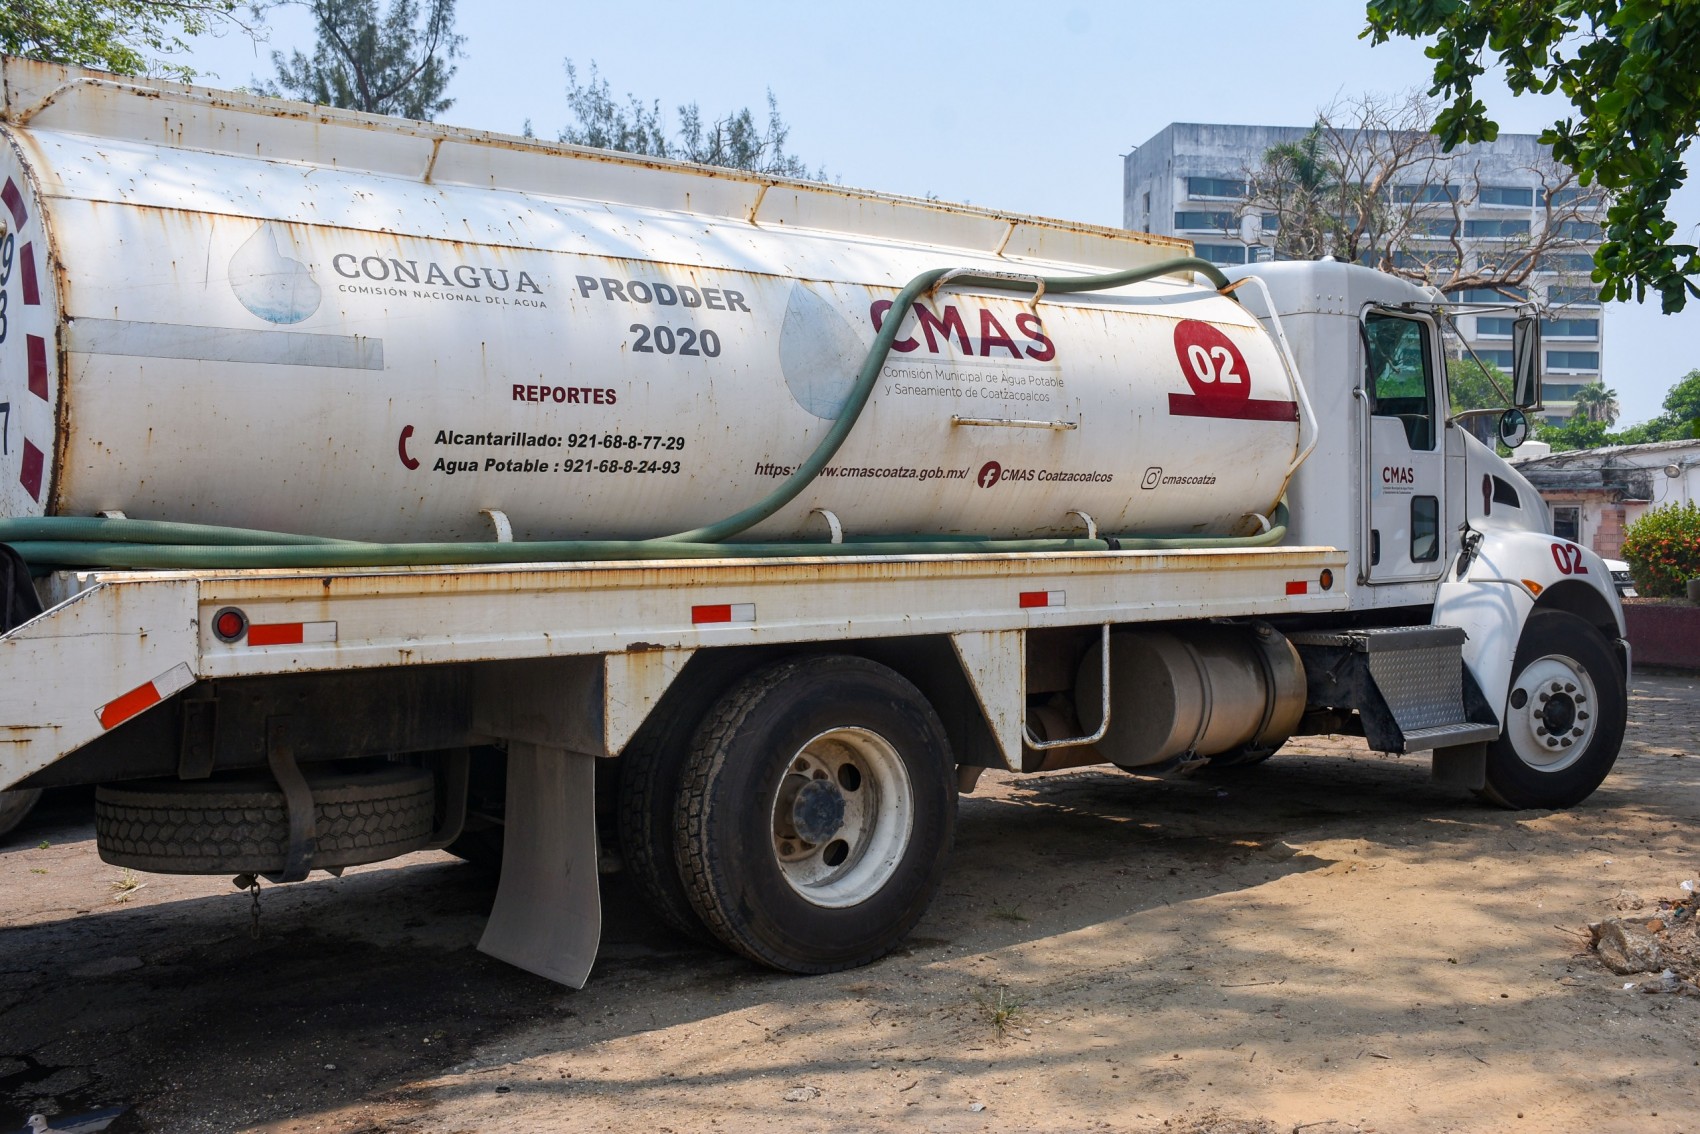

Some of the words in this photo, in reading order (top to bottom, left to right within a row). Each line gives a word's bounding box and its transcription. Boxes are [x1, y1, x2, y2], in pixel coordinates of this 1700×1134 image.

[332, 253, 544, 294] CONAGUA
[338, 284, 408, 297] COMISIÓN
[413, 290, 481, 303] NACIONAL
[486, 296, 510, 305] DEL
[514, 299, 547, 309] AGUA
[575, 275, 751, 313] PRODDER
[629, 323, 722, 358] 2020
[870, 299, 1056, 362] CMAS
[1187, 344, 1242, 384] 02
[883, 366, 933, 380] Comisión
[935, 369, 983, 383] Municipal
[985, 372, 998, 383] de
[1001, 373, 1026, 386] Agua
[1028, 375, 1064, 388] Potable
[512, 384, 617, 405] REPORTES
[884, 385, 892, 396] y
[895, 383, 963, 398] Saneamiento
[965, 386, 978, 398] de
[980, 387, 1050, 402] Coatzacoalcos
[434, 430, 562, 447] Alcantarillado:
[567, 433, 685, 450] 921-68-8-77-29
[432, 457, 479, 475] Agua
[484, 458, 549, 473] Potable
[563, 458, 681, 474] 921-68-8-24-93
[1000, 469, 1035, 482] CMAS
[1037, 469, 1114, 483] Coatzacoalcos
[1382, 466, 1414, 484] CMAS
[1162, 474, 1217, 485] cmascoatza
[1551, 543, 1589, 575] 02
